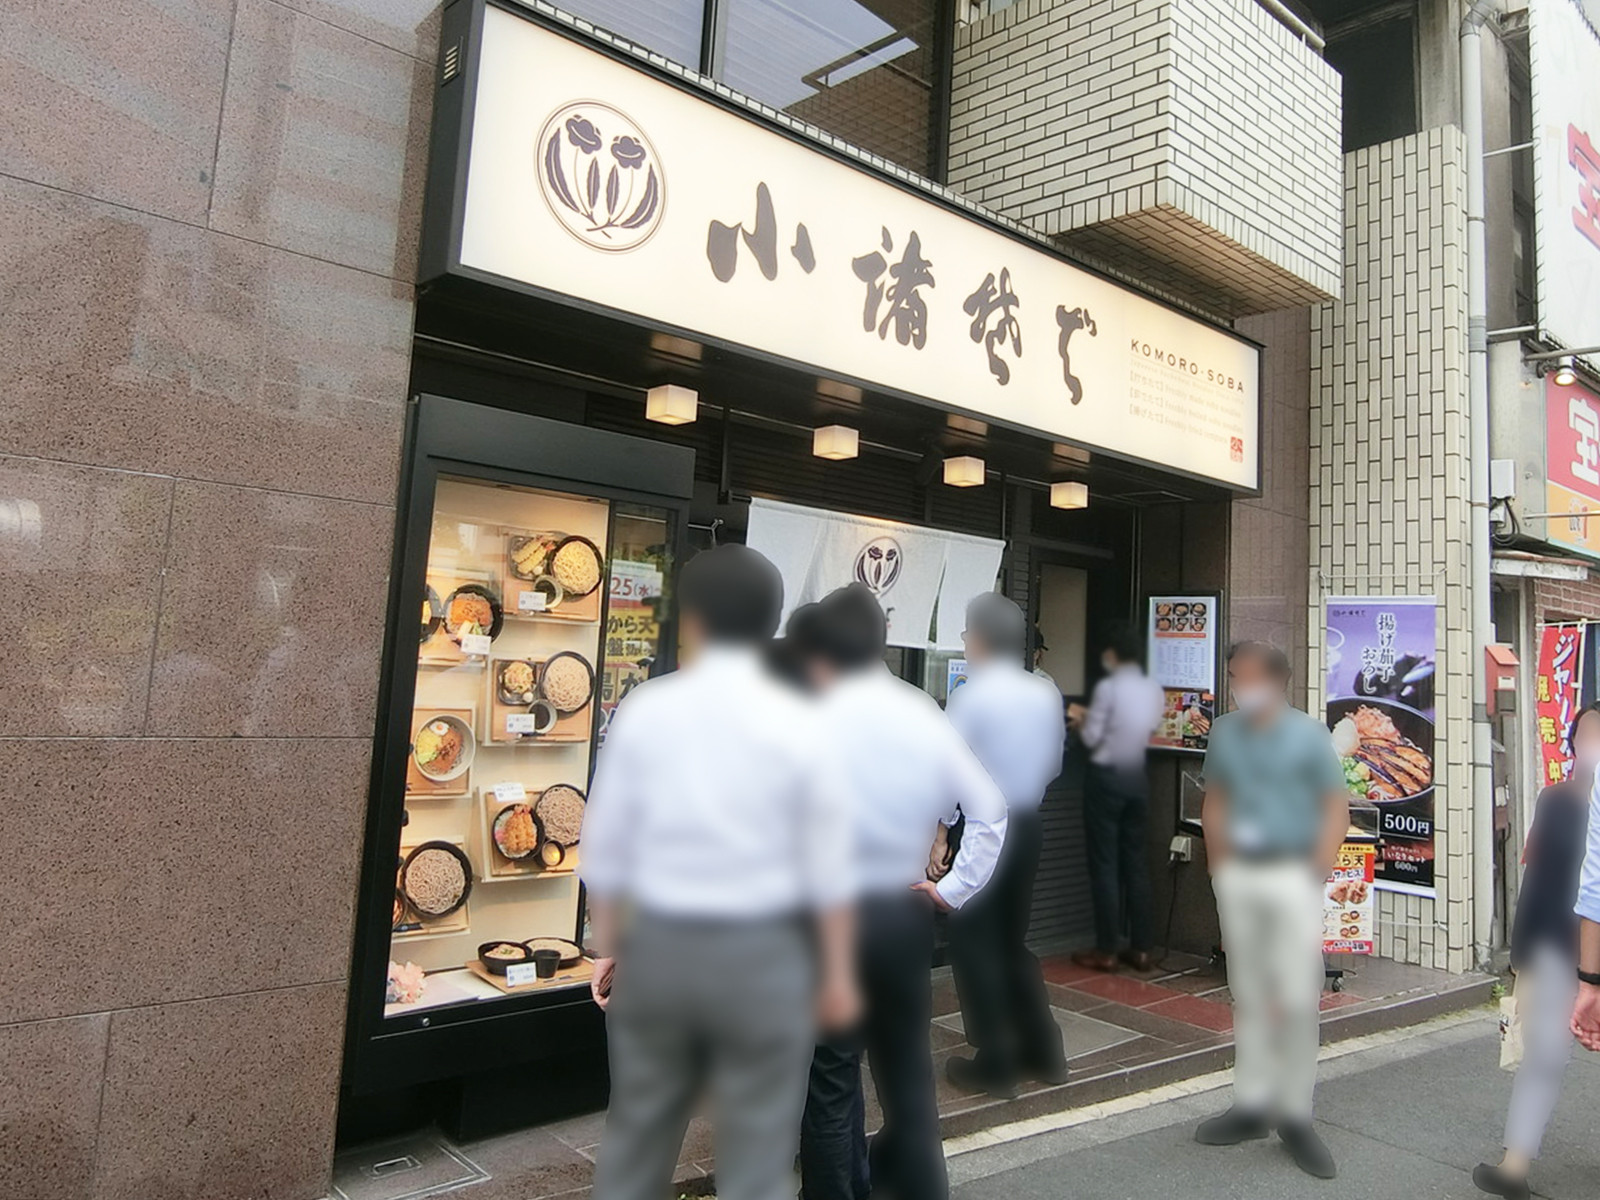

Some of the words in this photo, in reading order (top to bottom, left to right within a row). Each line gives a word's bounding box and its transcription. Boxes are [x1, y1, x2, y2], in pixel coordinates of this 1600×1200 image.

[1378, 613, 1396, 682] 揚げ茄子
[1362, 648, 1377, 693] おろし
[1384, 813, 1429, 834] 500円
